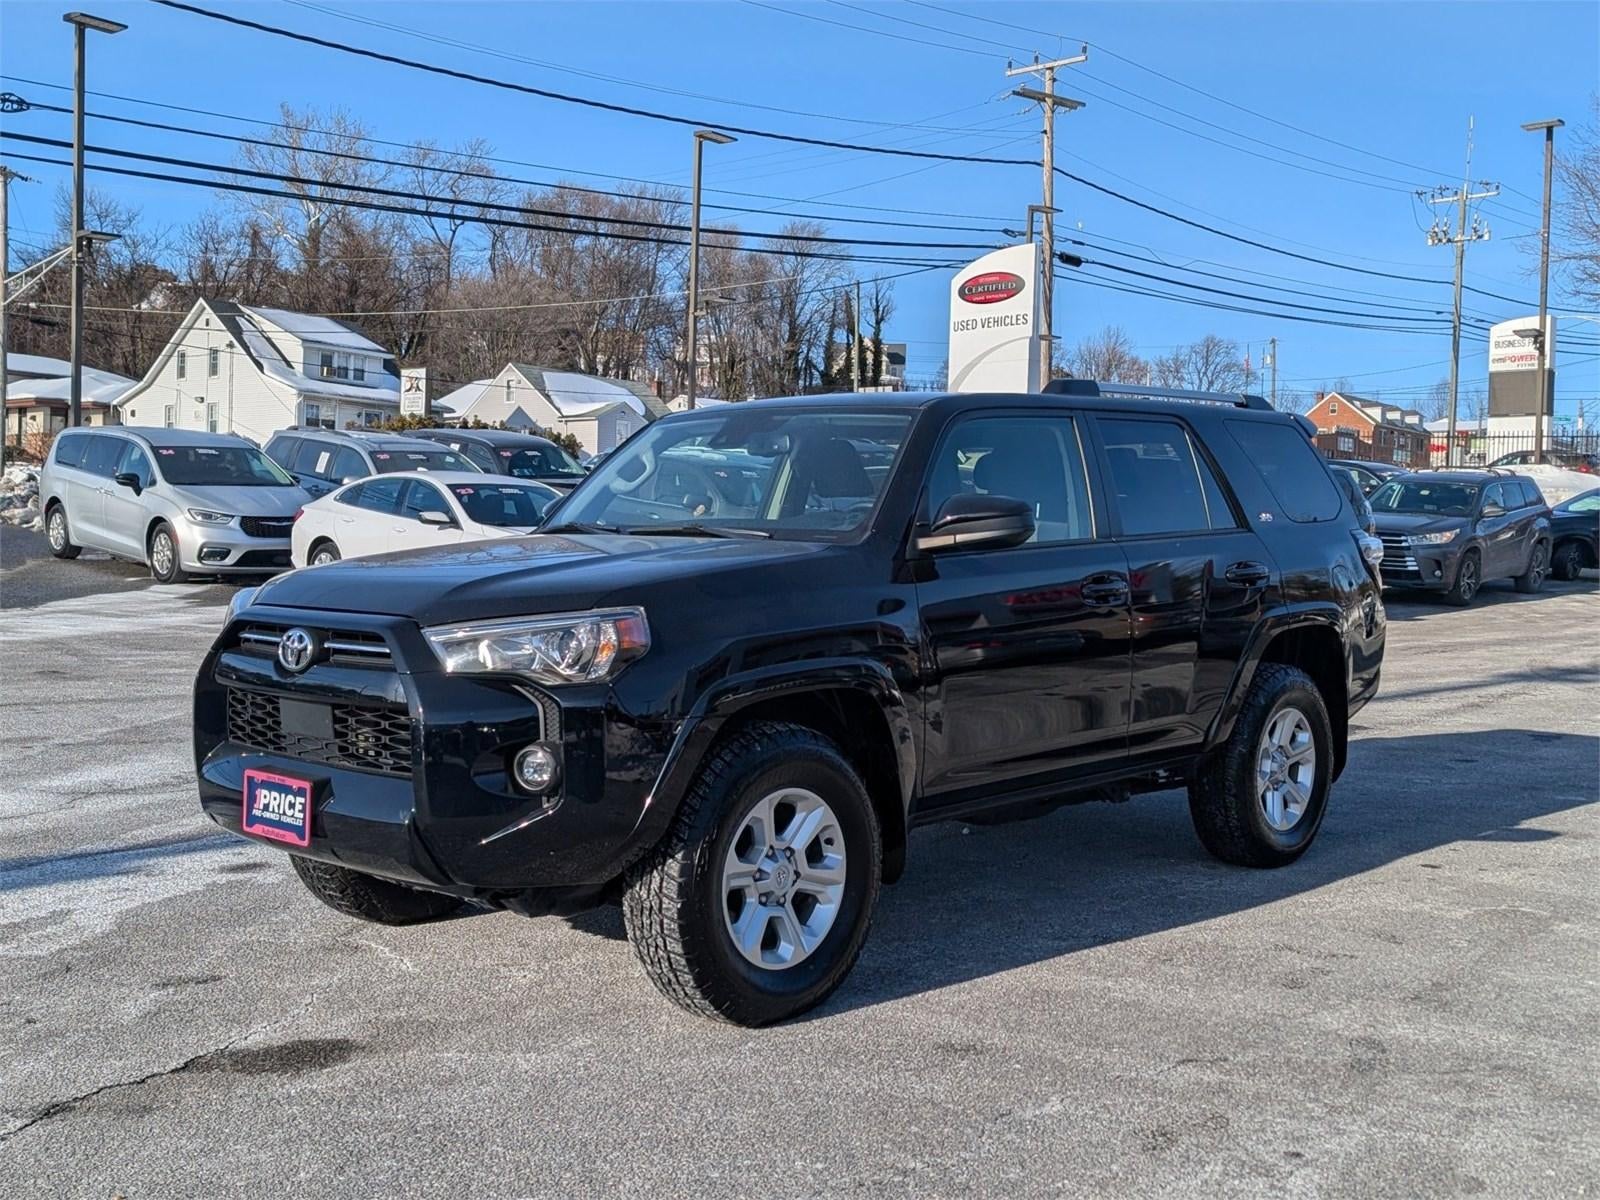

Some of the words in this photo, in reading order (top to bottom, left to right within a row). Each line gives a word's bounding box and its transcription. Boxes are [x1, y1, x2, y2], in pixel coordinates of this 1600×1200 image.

[965, 282, 1016, 295] CERTIFIED
[953, 318, 978, 333] USED
[980, 313, 1029, 329] VEHICLES
[1494, 339, 1527, 349] BUSINESS
[252, 809, 280, 821] PRE-OWNED
[280, 814, 304, 826] VEHICLES
